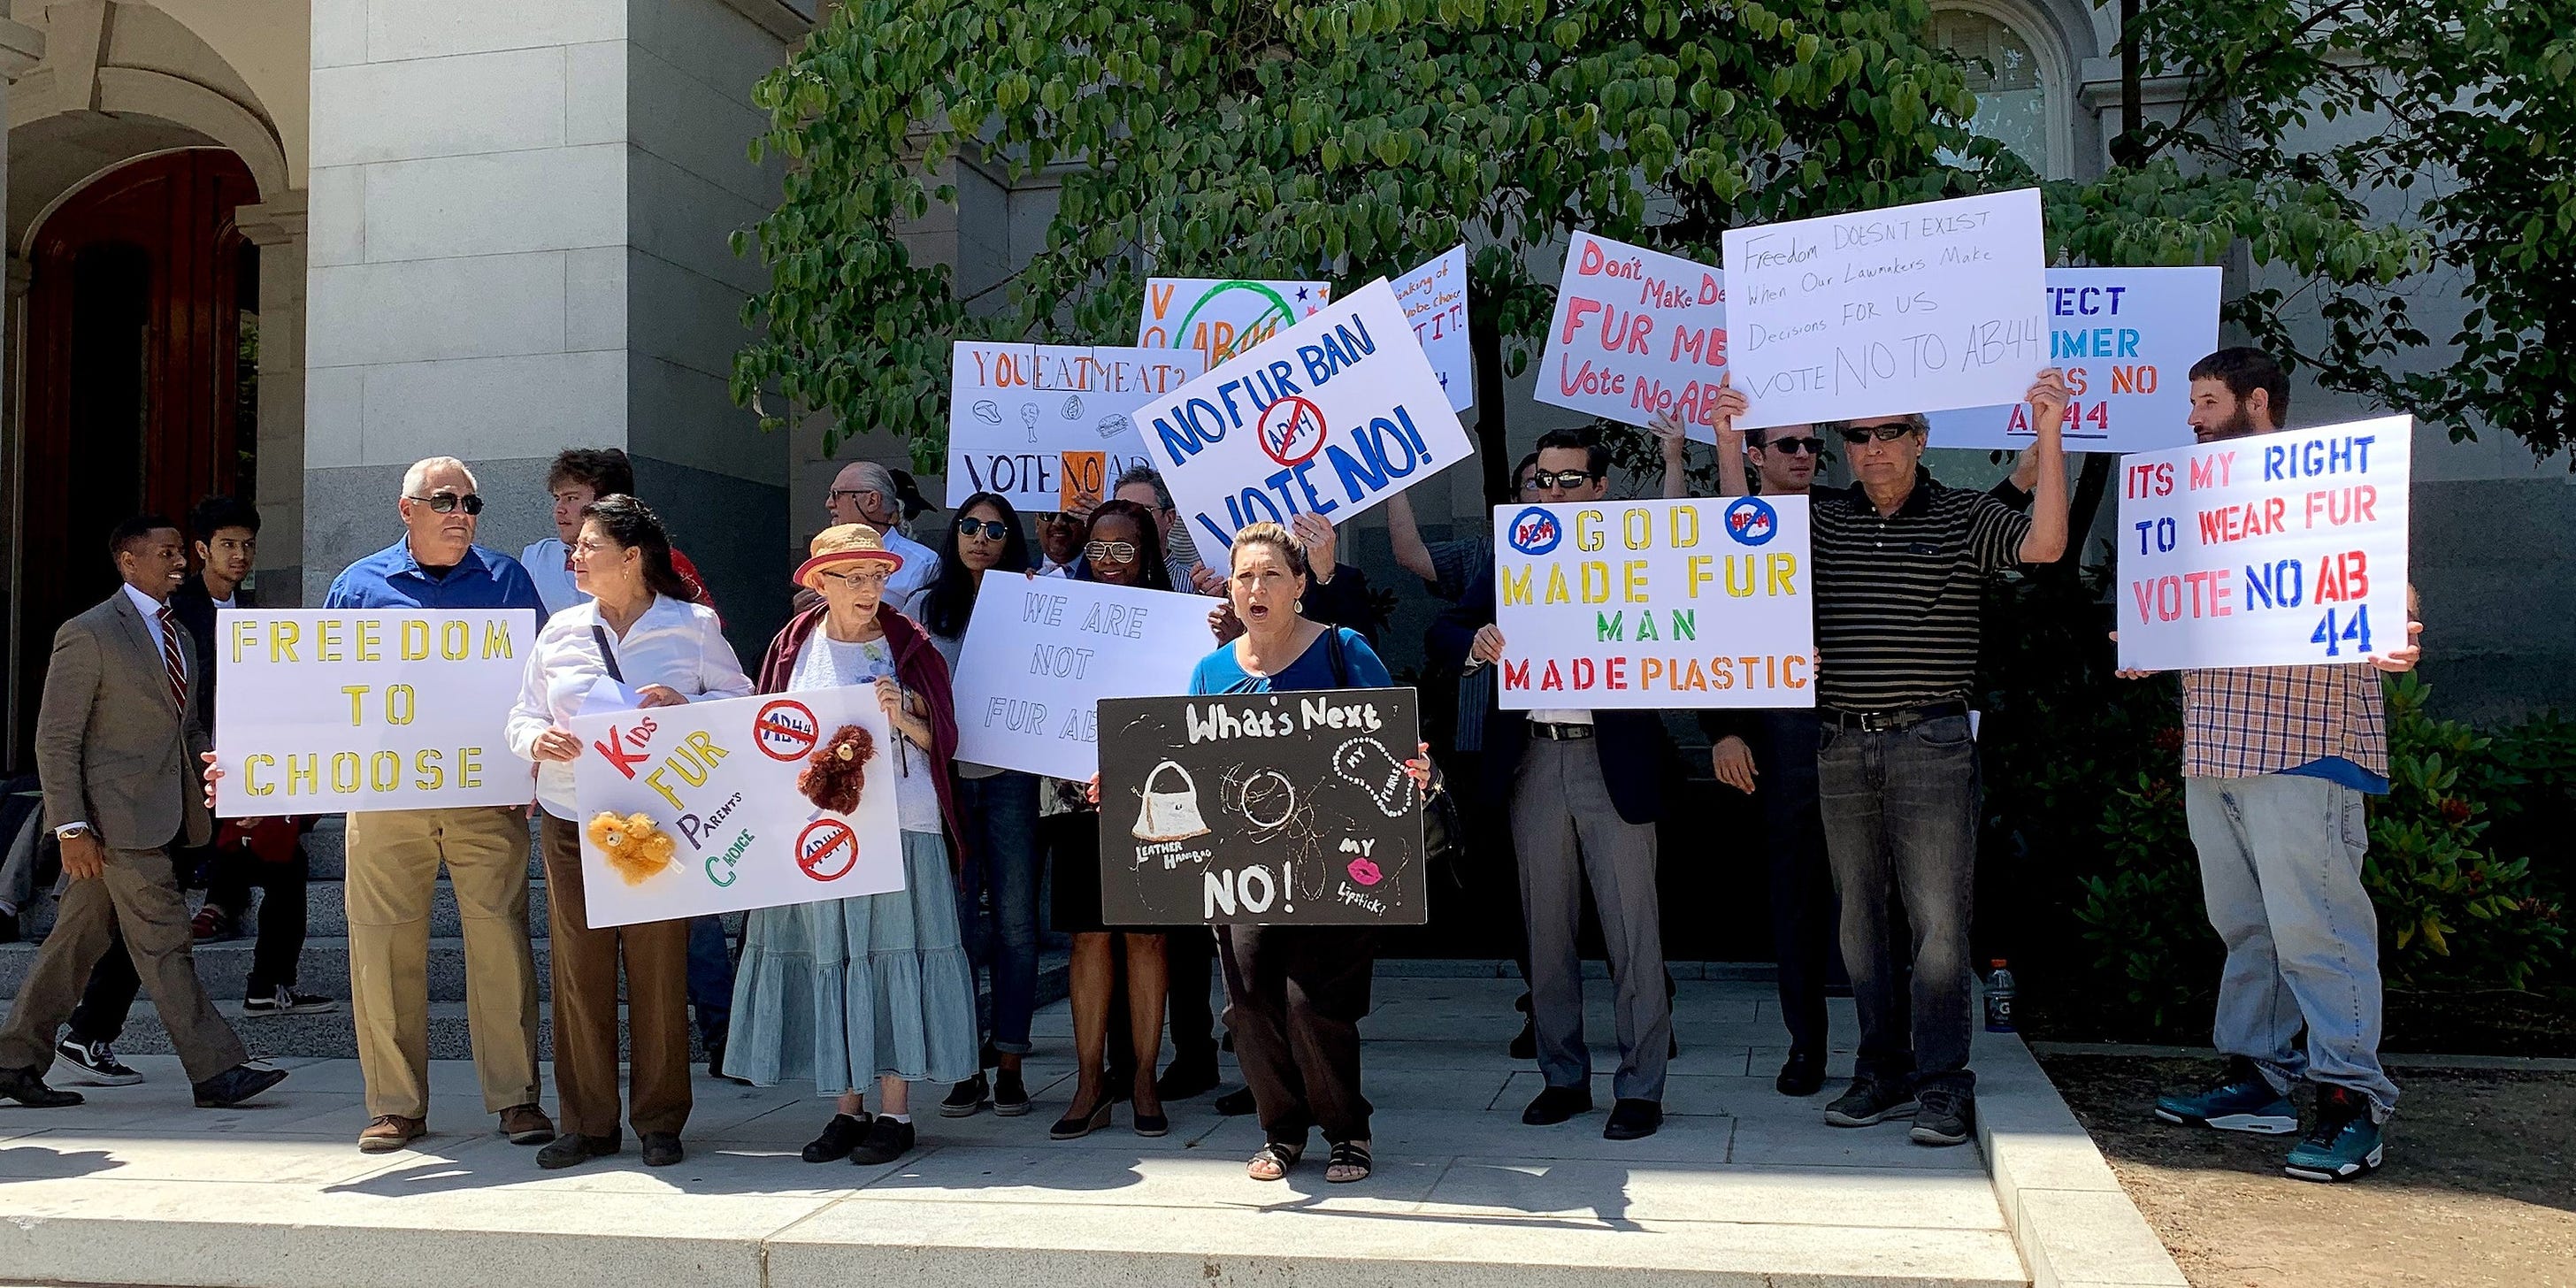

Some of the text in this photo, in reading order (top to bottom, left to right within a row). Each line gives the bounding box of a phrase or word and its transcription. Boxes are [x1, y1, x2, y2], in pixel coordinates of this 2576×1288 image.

[1744, 233, 1818, 273] Freedom
[1921, 211, 1990, 238] EXIST
[1436, 259, 1448, 278] of
[1578, 239, 1643, 280] Don't
[1639, 276, 1693, 309] Make
[1747, 246, 1993, 307] When Our Lawmakers Make
[1433, 289, 1460, 308] choice
[1747, 291, 1938, 351] Decisions FOR US
[2046, 287, 2126, 316] ECT
[1561, 295, 1728, 367] FUR ME
[972, 350, 1031, 388] YOU
[1036, 355, 1094, 390] EAT
[1744, 315, 2040, 400] VOTE NO TO AB44
[2111, 365, 2158, 394] NO
[1152, 313, 1376, 467] NO FUR BAN
[1560, 353, 1626, 396] Vote
[1629, 376, 1673, 413] No
[2006, 401, 2108, 432] A44
[963, 453, 1061, 494] VOTE
[1062, 455, 1102, 494] NO
[1195, 404, 1433, 552] VOTE NO!
[2128, 435, 2375, 499] ITS MY RIGHT
[1575, 505, 1700, 552] GOD
[2135, 485, 2378, 556] TO WEAR FUR
[1501, 551, 1798, 607] MADE FUR
[2132, 549, 2369, 625] VOTE NO AB
[1023, 592, 1148, 640] WE ARE
[1596, 608, 1697, 643] MAN
[2310, 603, 2373, 657] 44
[232, 619, 514, 663] FREEDOM
[1030, 643, 1094, 680] NOT
[1503, 655, 1807, 693] MADE PLASTIC
[341, 684, 417, 727] TO
[984, 696, 1048, 736] FUR
[1185, 695, 1384, 745] What's Next
[243, 748, 483, 796] CHOOSE
[644, 730, 731, 811] FUR
[1346, 746, 1366, 769] MY
[705, 828, 756, 888] CHOICE
[1135, 841, 1184, 863] LEATHER
[1338, 837, 1376, 857] MY
[1203, 860, 1295, 920] NO!
[1999, 1001, 2011, 1015] G
